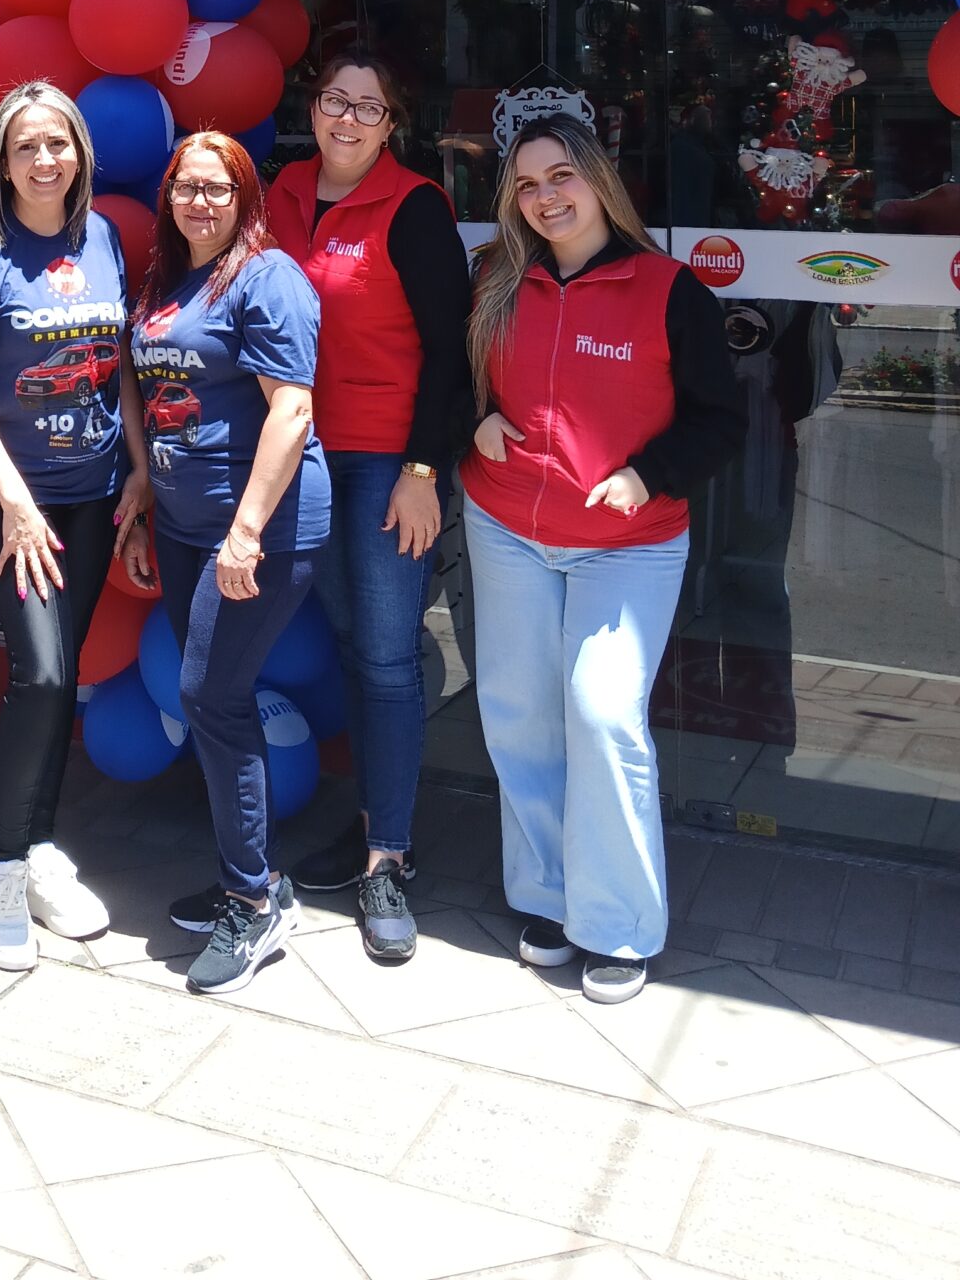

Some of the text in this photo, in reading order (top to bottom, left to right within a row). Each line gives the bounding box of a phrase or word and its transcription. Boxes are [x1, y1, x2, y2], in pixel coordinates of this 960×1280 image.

[325, 240, 365, 259] mundi
[692, 252, 741, 269] mundi
[812, 272, 837, 285] LOJAS
[34, 325, 118, 342] PREMIADA
[575, 339, 633, 361] mundi
[34, 414, 74, 432] +10
